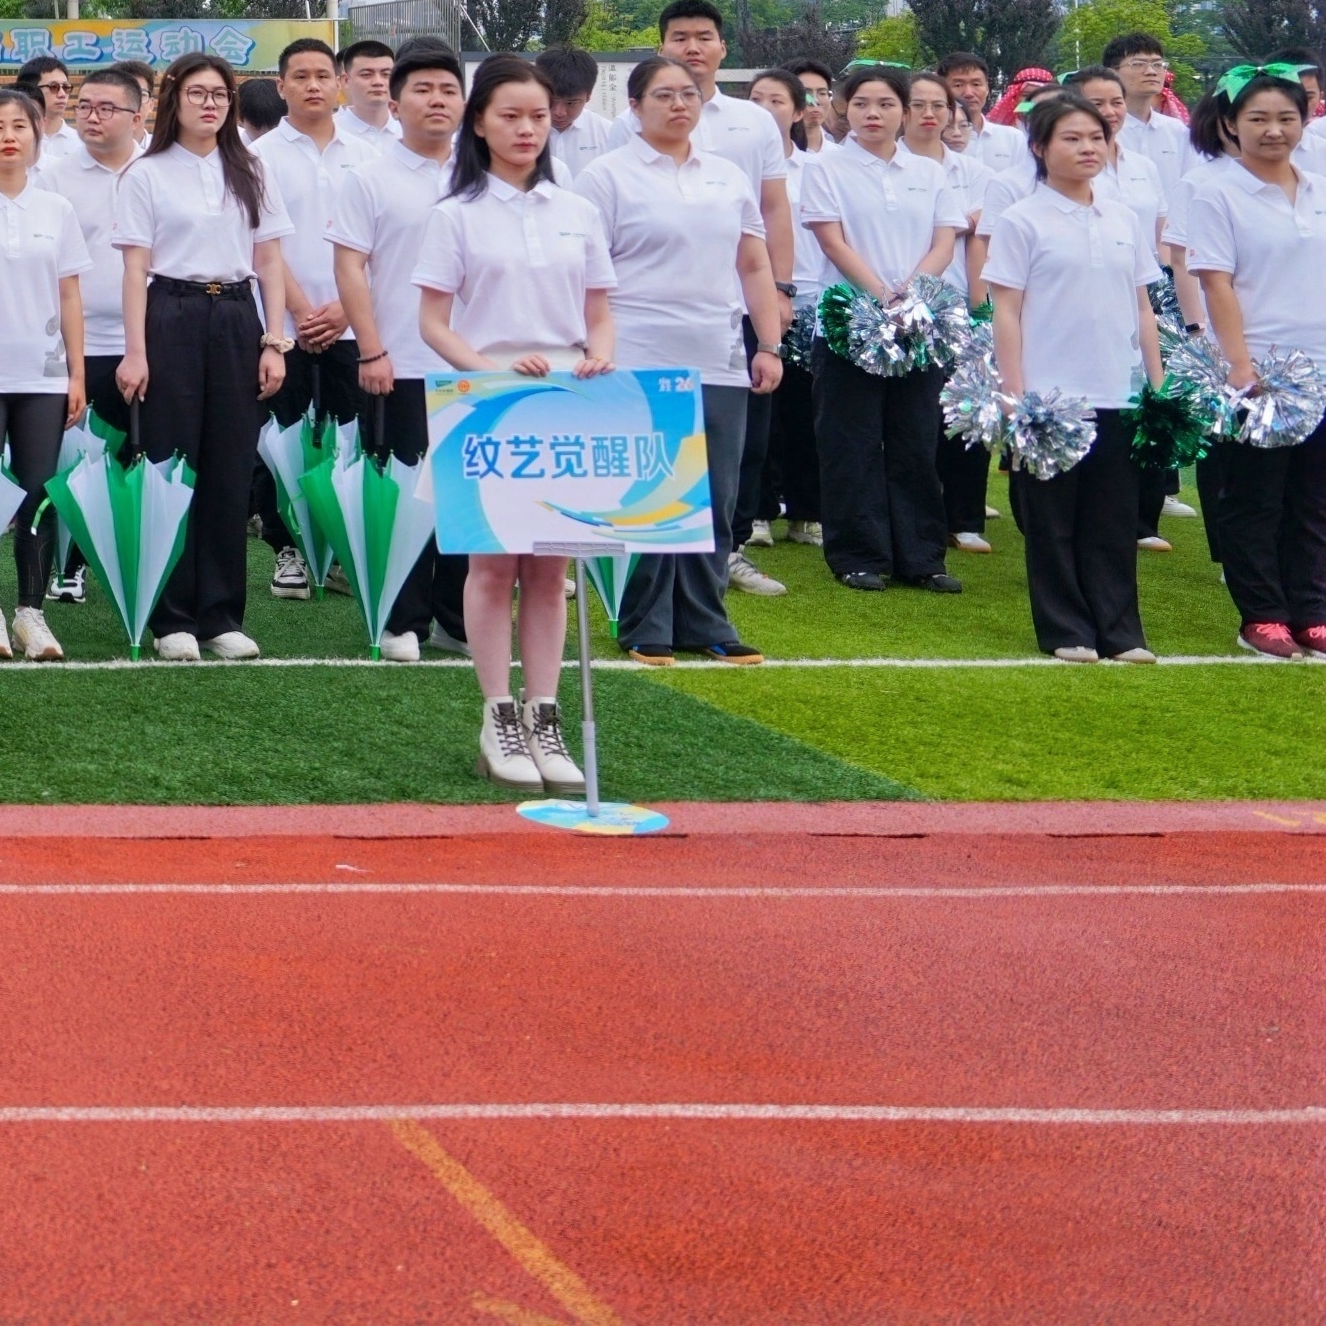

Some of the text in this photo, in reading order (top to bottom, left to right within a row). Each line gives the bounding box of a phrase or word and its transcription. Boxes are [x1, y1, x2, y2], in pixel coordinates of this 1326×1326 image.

[464, 434, 676, 480] 纹艺觉醒队
